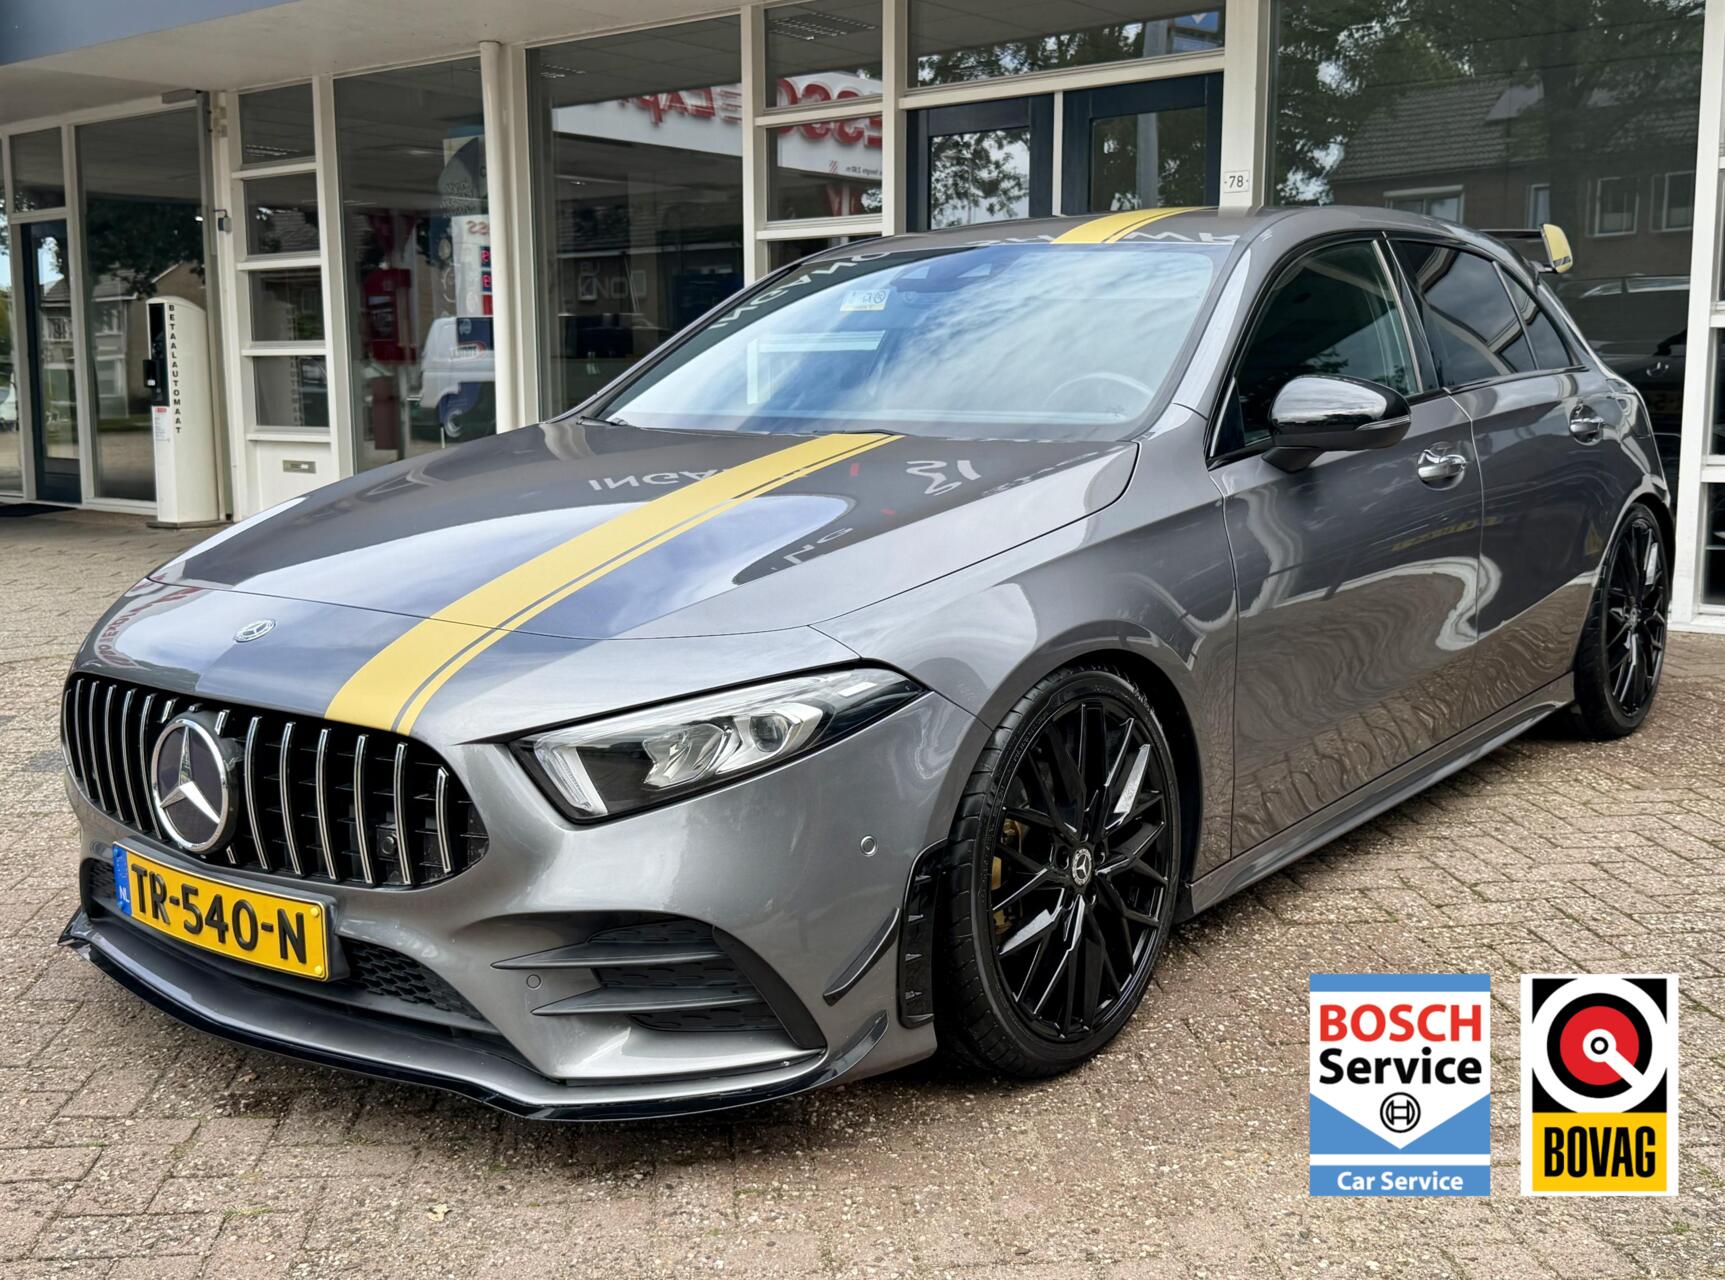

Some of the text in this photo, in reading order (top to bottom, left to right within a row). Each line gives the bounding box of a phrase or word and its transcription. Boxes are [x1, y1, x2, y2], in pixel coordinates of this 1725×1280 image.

[1229, 175, 1243, 188] 78
[168, 304, 182, 434] BETAALAUTOMAAT
[119, 885, 130, 903] NL
[131, 864, 307, 964] TR-540-N
